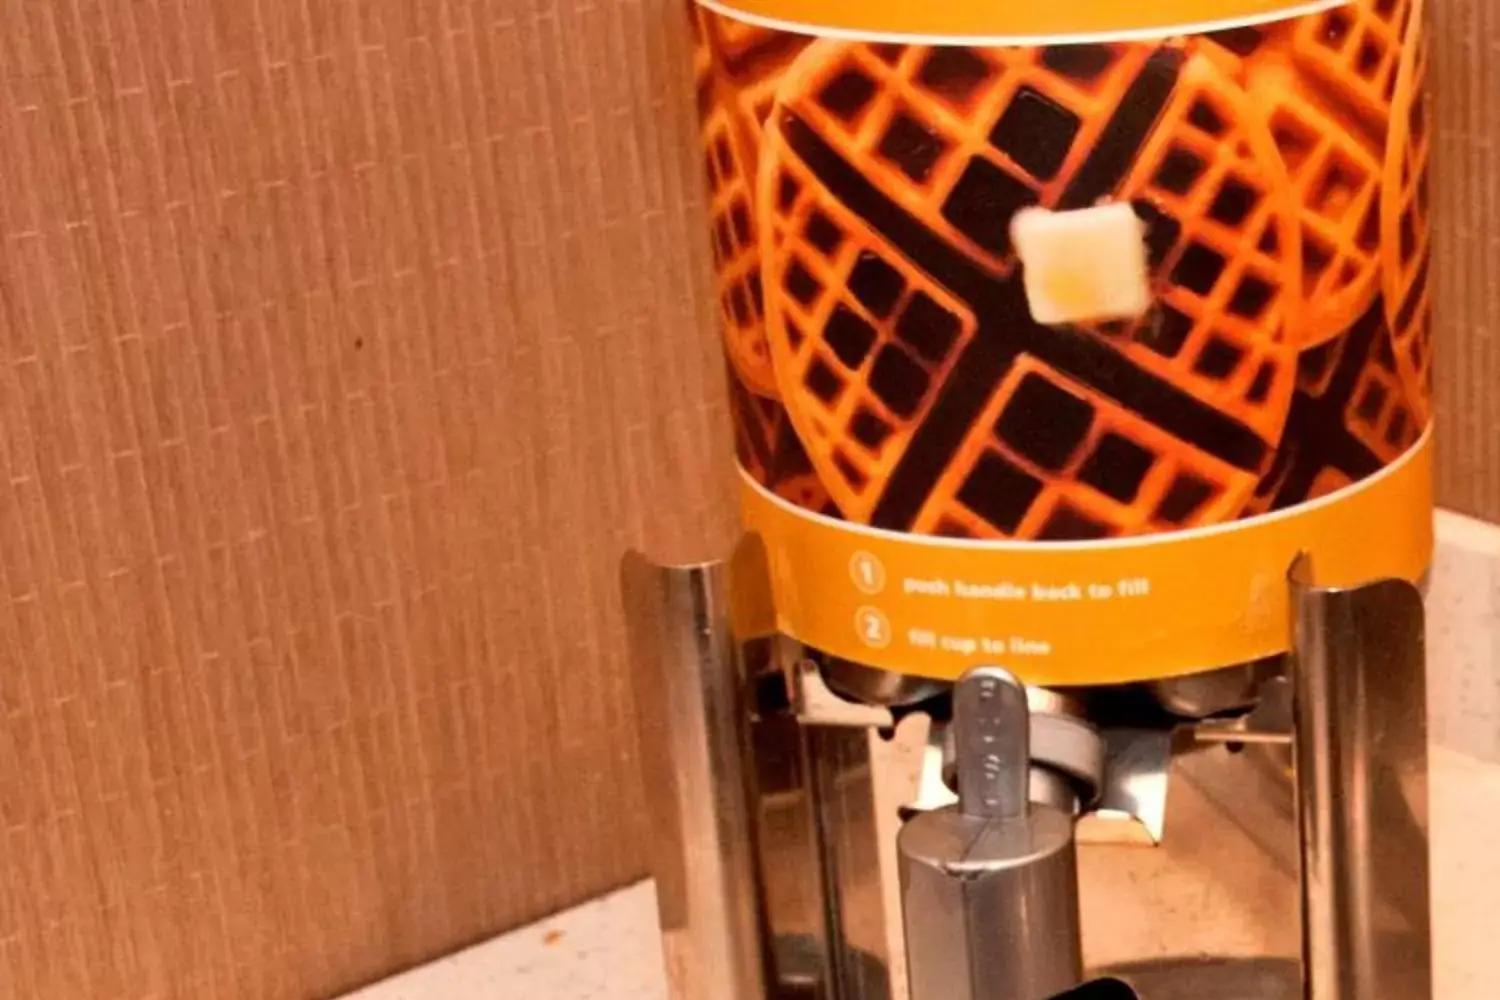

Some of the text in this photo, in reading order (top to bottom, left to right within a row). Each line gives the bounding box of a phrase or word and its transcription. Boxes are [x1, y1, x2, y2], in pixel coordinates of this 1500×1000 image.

[903, 576, 1149, 601] push handle back to fill
[940, 635, 978, 656] cup
[981, 635, 1005, 654] to
[1009, 634, 1052, 656] line
